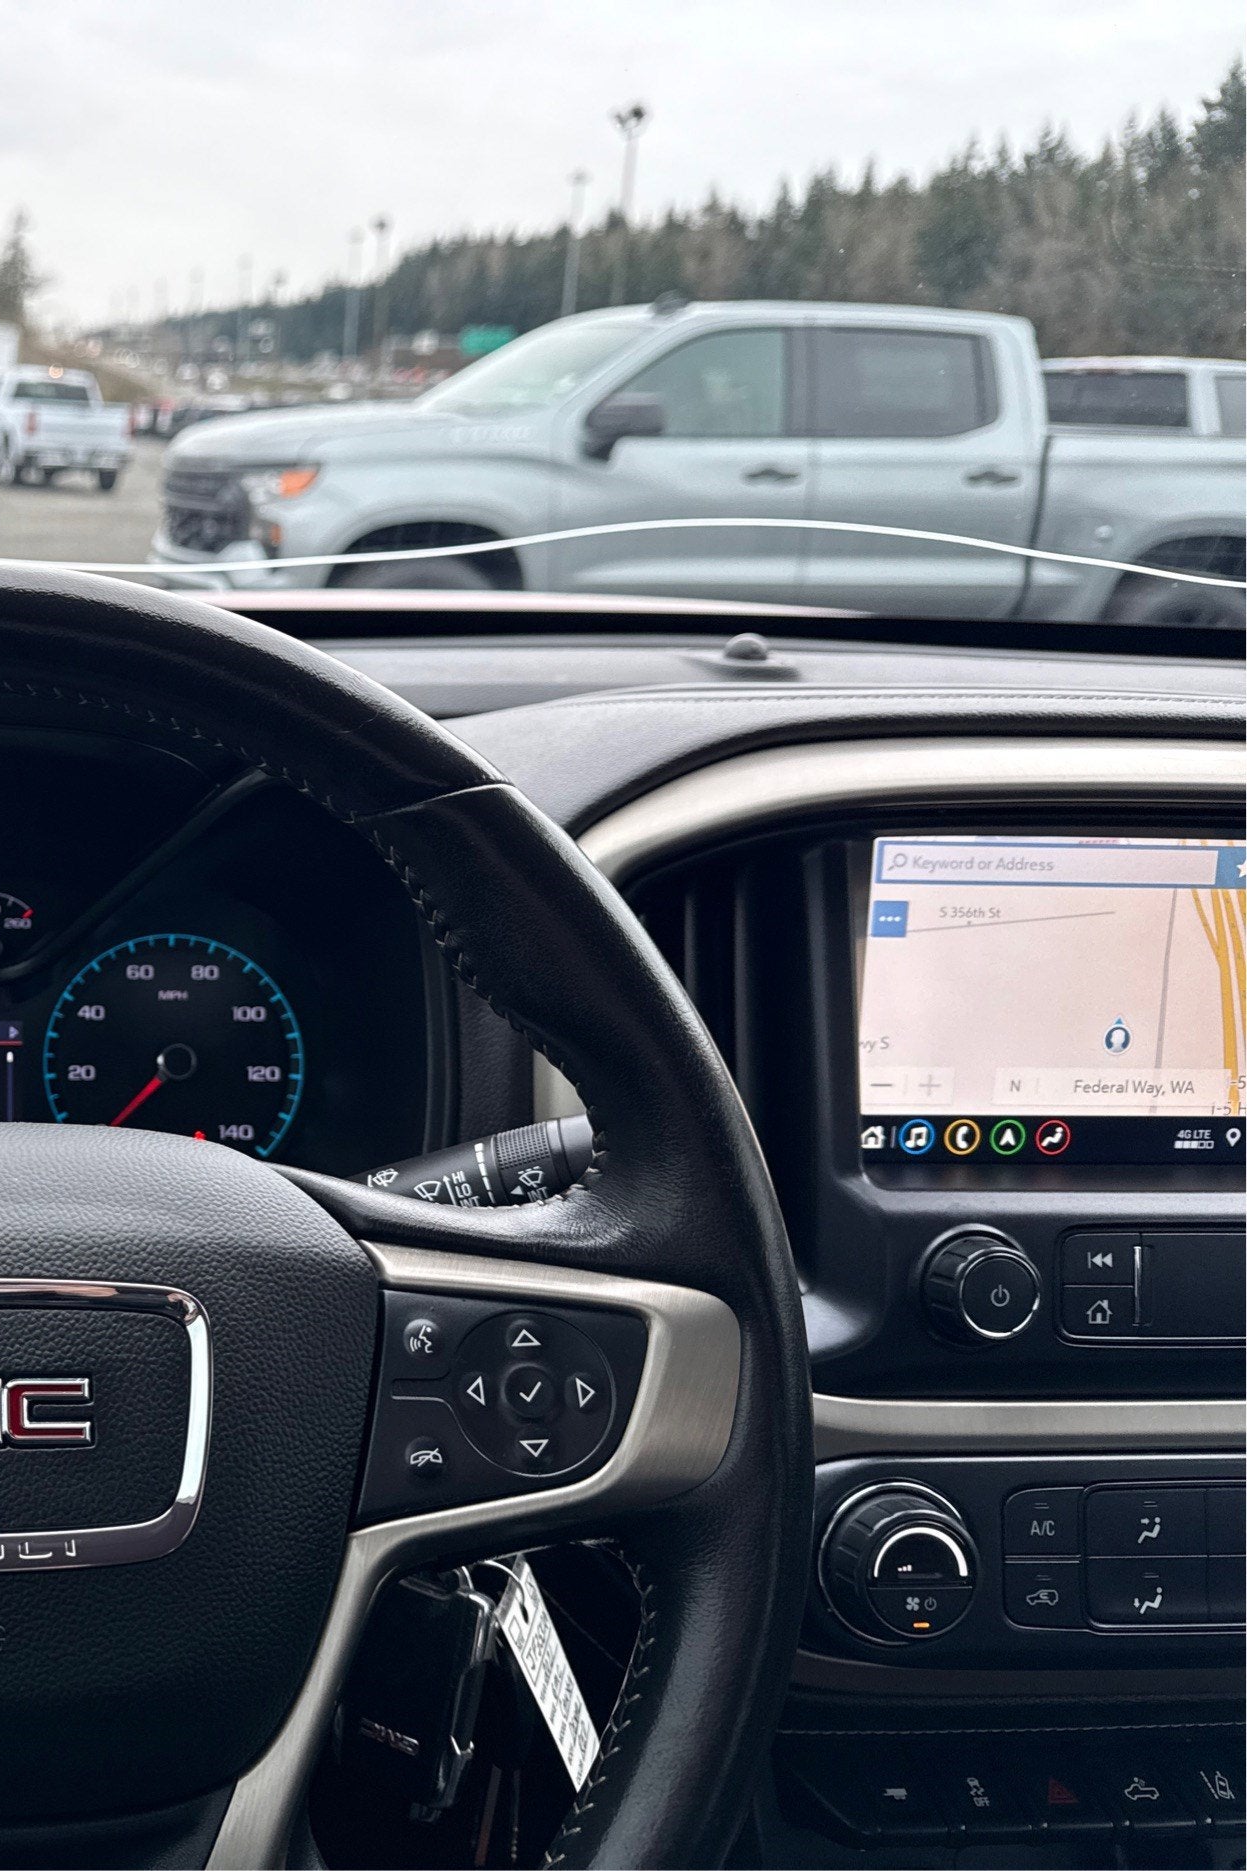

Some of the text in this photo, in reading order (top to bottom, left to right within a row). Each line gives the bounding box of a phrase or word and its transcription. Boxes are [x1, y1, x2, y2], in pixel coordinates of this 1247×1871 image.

[912, 856, 1055, 873] Keyword or Address
[940, 906, 1002, 919] S 356th St
[4, 917, 32, 929] 260
[125, 964, 154, 981] 60
[191, 965, 219, 981] 80
[158, 990, 188, 1001] MPH
[77, 1005, 105, 1021] 40
[232, 1006, 267, 1022] 100
[881, 1037, 889, 1049] S
[68, 1064, 96, 1081] 20
[247, 1065, 281, 1082] 120
[1010, 1080, 1021, 1092] N
[1074, 1080, 1195, 1098] Federal Way, WA
[219, 1124, 253, 1140] 140
[1177, 1129, 1212, 1139] 4G LTE
[451, 1171, 465, 1183] HI
[455, 1184, 473, 1197] LO
[527, 1187, 547, 1202] INT
[1030, 1521, 1056, 1537] A/C
